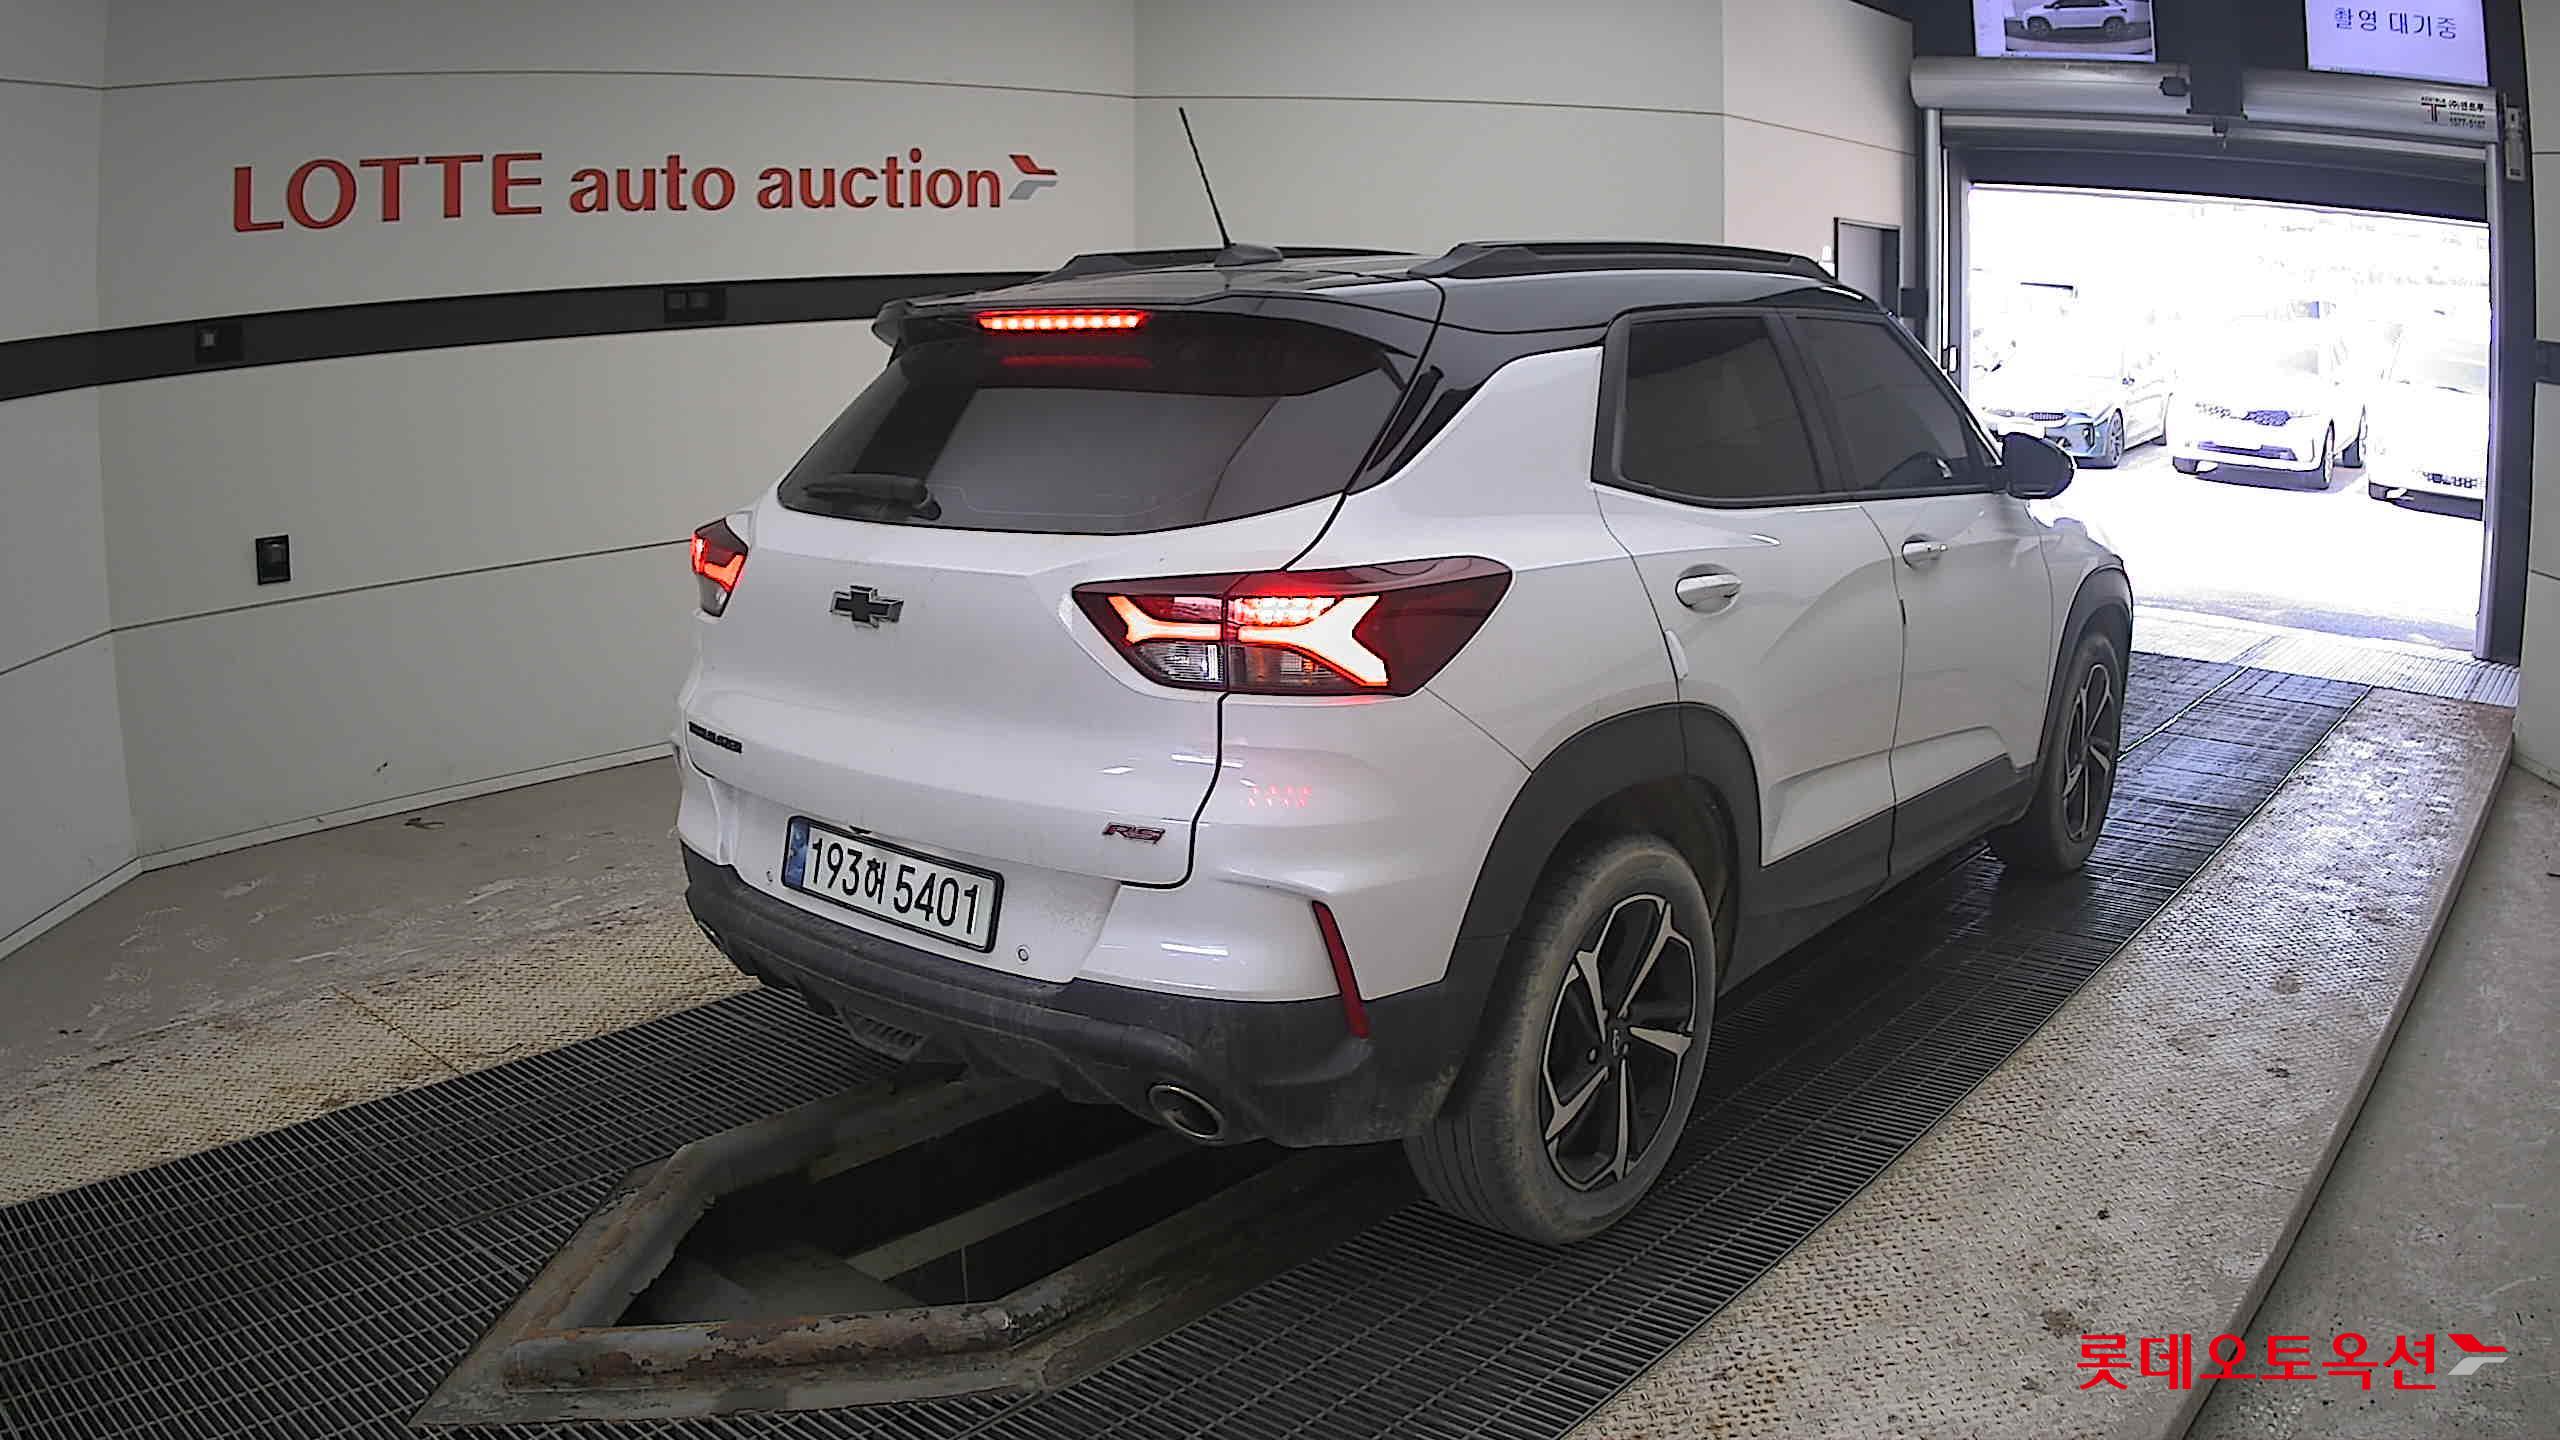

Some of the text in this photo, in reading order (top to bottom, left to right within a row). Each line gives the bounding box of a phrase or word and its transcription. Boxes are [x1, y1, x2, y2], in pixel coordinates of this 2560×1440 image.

[2389, 12, 2457, 40] 대기중
[234, 147, 1002, 232] LOTTE auto auction
[1102, 822, 1166, 845] RS
[812, 837, 979, 935] 193허 5401
